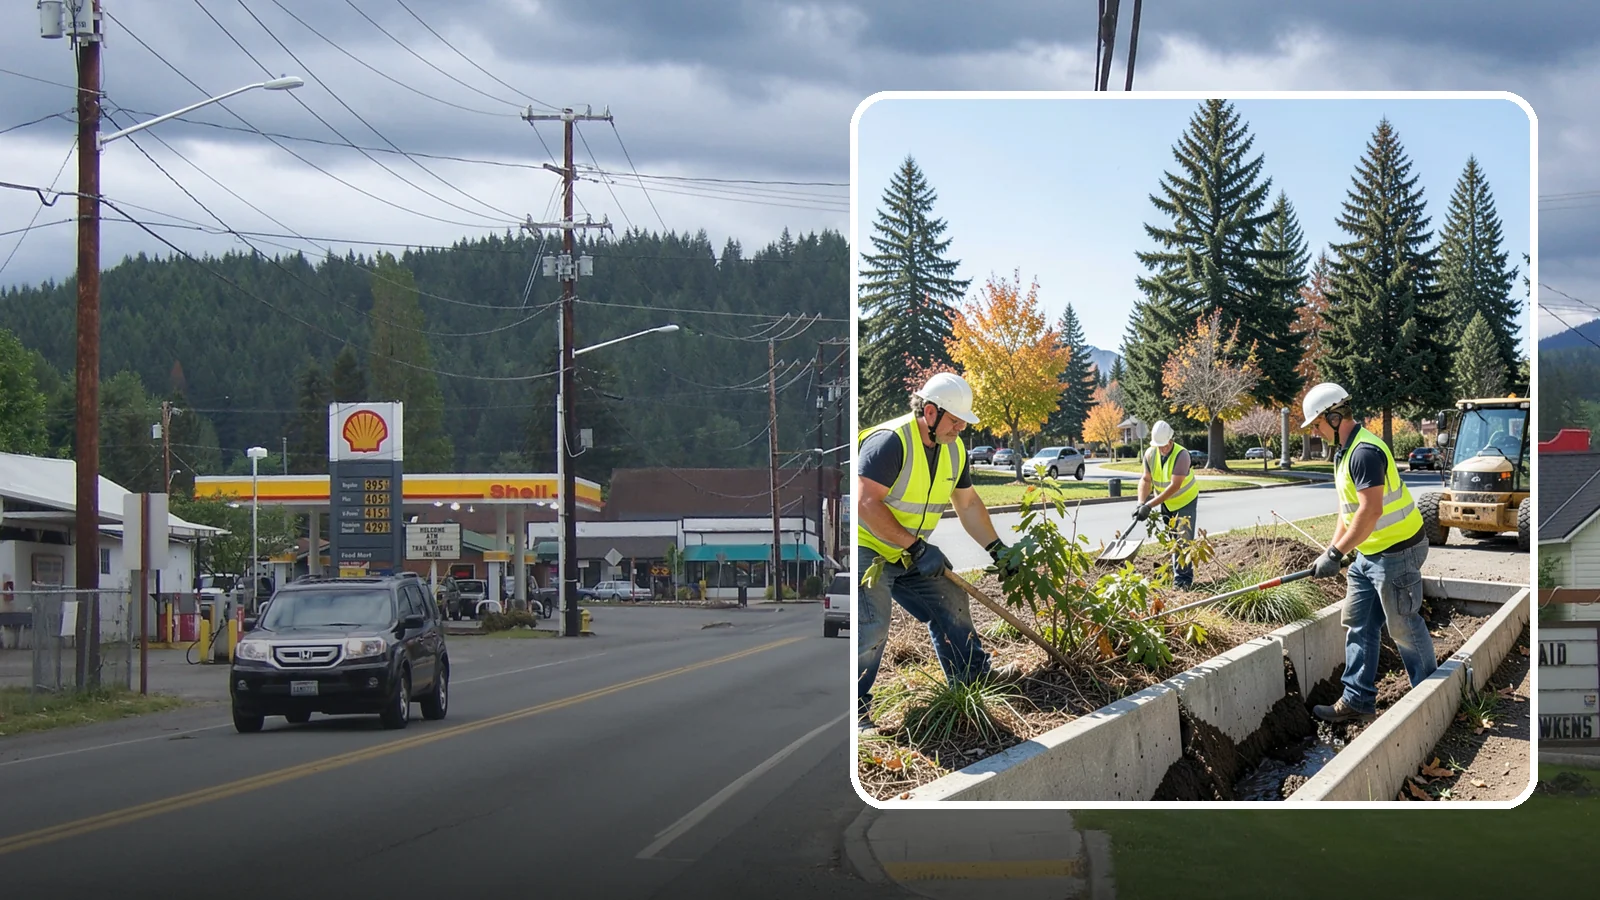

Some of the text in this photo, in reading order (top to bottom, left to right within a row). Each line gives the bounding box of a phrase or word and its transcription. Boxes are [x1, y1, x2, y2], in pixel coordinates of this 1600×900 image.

[366, 480, 383, 490] 395
[490, 484, 547, 499] Shell
[366, 494, 383, 504] 405
[366, 508, 383, 518] 415
[366, 522, 384, 532] 429
